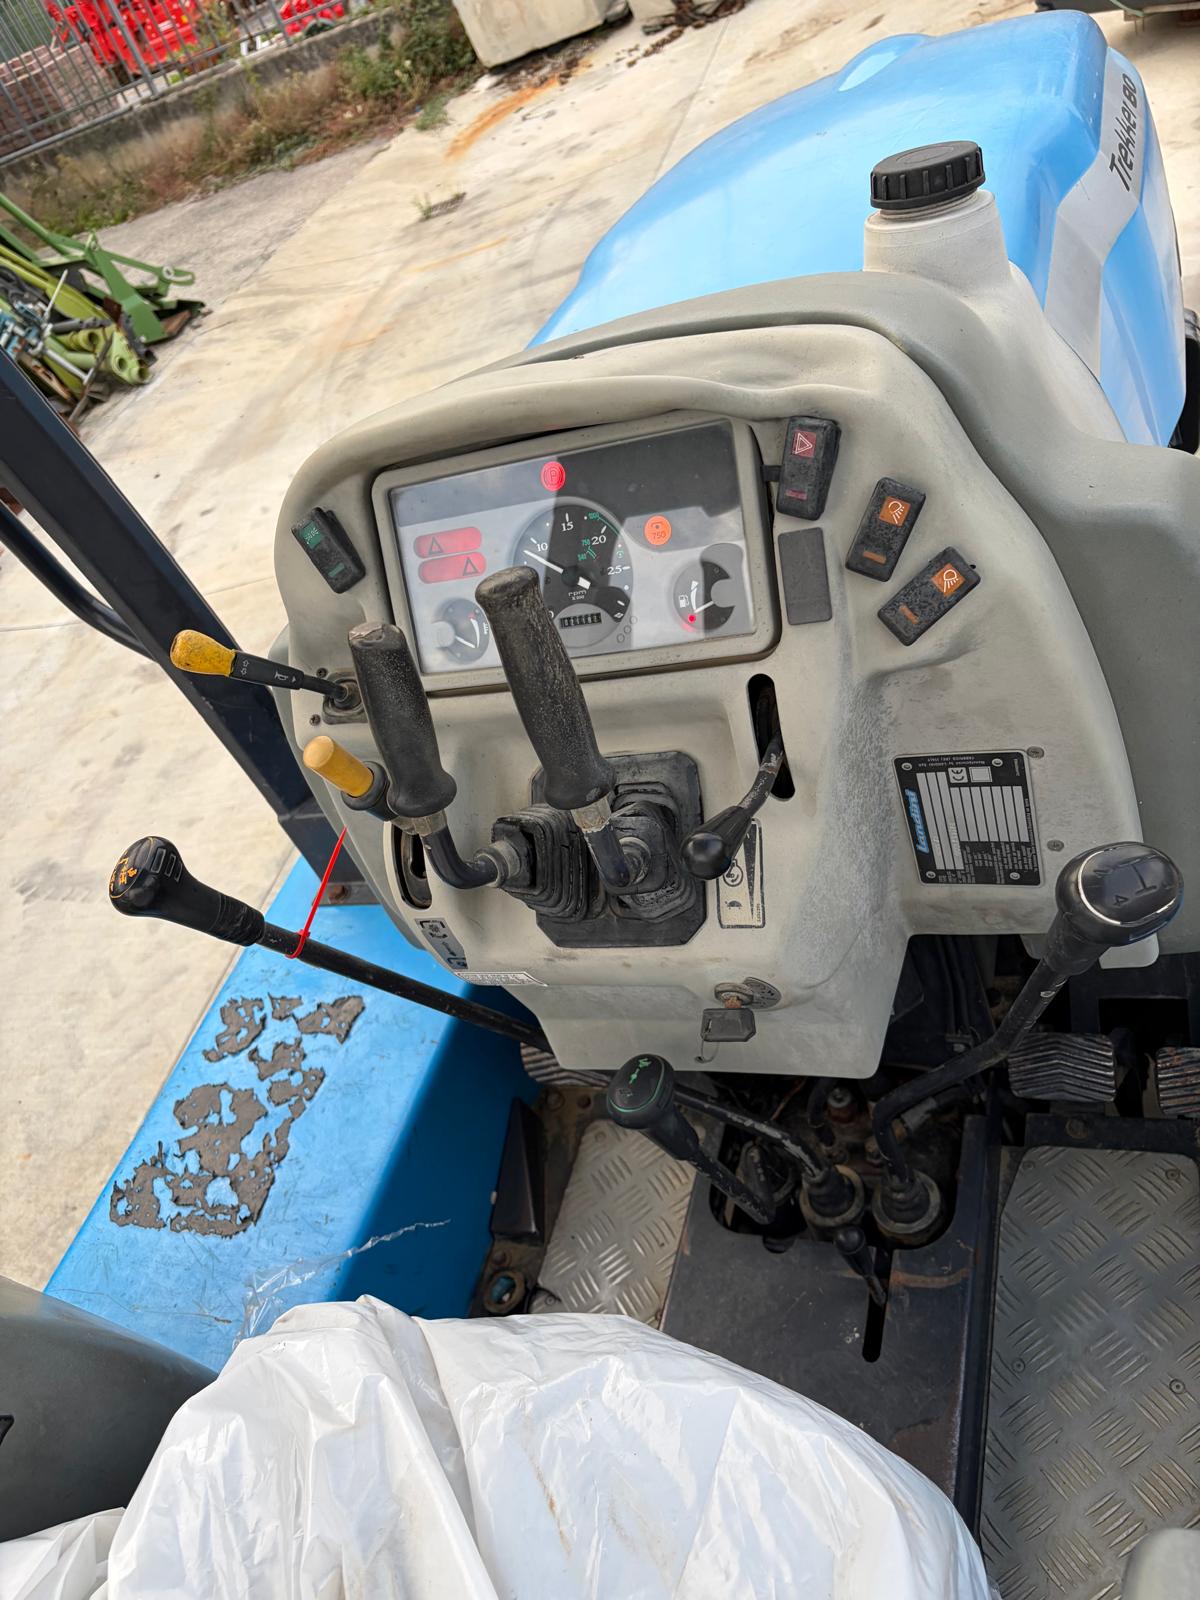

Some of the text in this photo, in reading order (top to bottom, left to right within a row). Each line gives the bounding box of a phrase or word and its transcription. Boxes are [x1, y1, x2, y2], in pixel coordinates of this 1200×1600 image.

[1109, 73, 1138, 191] Trekker 80
[561, 522, 574, 531] 15
[591, 535, 606, 545] 20
[653, 531, 667, 539] 750
[536, 542, 548, 551] 10
[607, 565, 622, 575] 25
[904, 788, 930, 854] Landini
